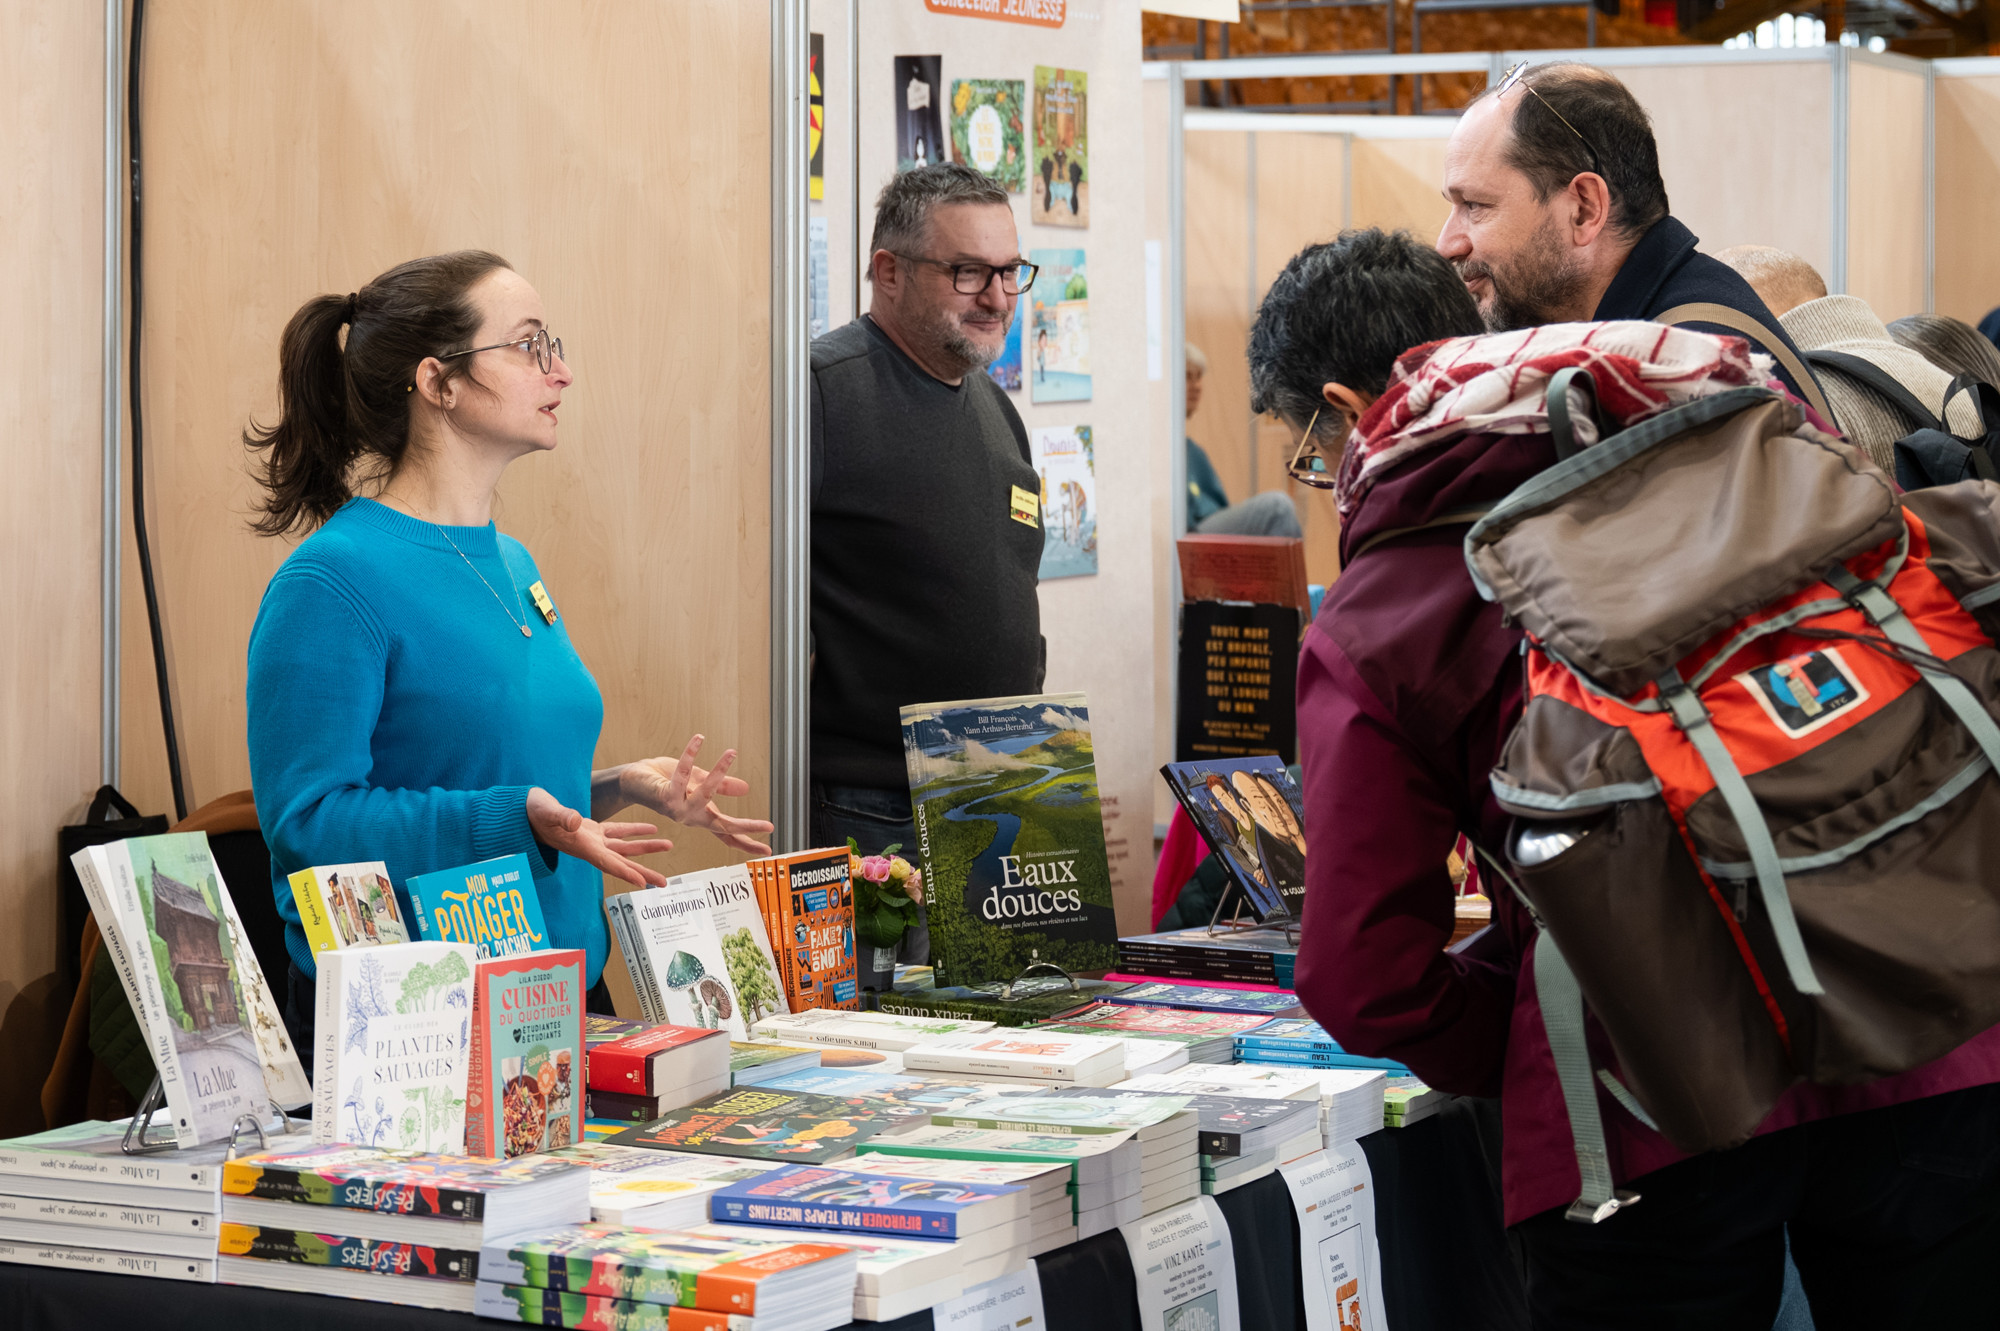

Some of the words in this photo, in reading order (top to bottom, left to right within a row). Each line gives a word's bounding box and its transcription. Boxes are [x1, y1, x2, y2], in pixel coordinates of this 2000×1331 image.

[1002, 0, 1064, 22] JEUNESSE
[1210, 625, 1240, 638] TOUTE
[1243, 627, 1269, 640] MORT
[1206, 640, 1224, 652] EST
[1207, 655, 1227, 667] PEU
[1229, 656, 1270, 670] IMPORTE
[1206, 669, 1225, 682] QUE
[1207, 685, 1229, 697] SOIT
[1232, 686, 1269, 700] LONGUE
[1218, 700, 1232, 712] OU
[978, 716, 989, 724] Bill
[990, 714, 1017, 724] François
[963, 725, 981, 735] Yann
[982, 722, 1034, 734] Arthus-Bertrand
[917, 803, 931, 858] douces
[491, 873, 504, 889] MAUD
[504, 870, 521, 883] ROULOT
[790, 862, 850, 889] DÉCROISSANCE
[998, 854, 1078, 889] Eaux
[465, 873, 489, 900] MON
[924, 861, 937, 905] Eaux
[705, 880, 750, 908] rbres
[411, 894, 425, 916] ROULOT
[640, 896, 706, 921] champignons
[982, 886, 1081, 921] douces
[416, 914, 430, 932] MAUD
[434, 889, 542, 944] POTAGER
[107, 925, 128, 966] SAUVAGES
[810, 925, 842, 949] FAKE?
[518, 976, 532, 985] LILA
[785, 947, 796, 998] DÉCROISSANCE
[124, 966, 141, 1002] PLANTES
[644, 963, 666, 1021] champignons
[501, 980, 569, 1011] CUISINE
[630, 965, 653, 1023] champignons
[499, 1013, 513, 1026] DU
[518, 1004, 572, 1024] QUOTIDIEN
[881, 1003, 930, 1018] douces
[522, 1020, 561, 1034] ÉTUDIANTES
[375, 1032, 454, 1059] PLANTES
[816, 1034, 852, 1045] sauvages
[852, 1039, 877, 1049] fleurs
[158, 1035, 173, 1064] Mue
[1311, 1053, 1330, 1061] L'EAU
[528, 1051, 547, 1067] SIMPLE
[166, 1067, 177, 1083] La
[323, 1033, 335, 1115] SAUVAGES
[373, 1056, 453, 1085] SAUVAGES
[193, 1071, 213, 1098] La
[211, 1065, 238, 1092] Mue
[120, 1166, 144, 1179] Mue
[147, 1168, 160, 1181] La
[1300, 1178, 1313, 1187] SALON
[462, 1197, 471, 1218] Tana
[748, 1204, 802, 1222] INCERTAINS
[804, 1208, 839, 1225] TEMPS
[120, 1211, 144, 1224] Mue
[147, 1213, 160, 1226] La
[841, 1211, 861, 1226] PAR
[862, 1212, 922, 1231] BIFURQUER
[1150, 1224, 1167, 1235] SALON
[1171, 1232, 1177, 1241] ET
[118, 1257, 141, 1270] Mue
[1164, 1253, 1181, 1270] VINZ
[1181, 1240, 1204, 1263] KANTÉ
[144, 1260, 157, 1272] La
[459, 1257, 468, 1279] Tana
[651, 1278, 683, 1300] YOGA
[949, 1308, 968, 1322] SALON
